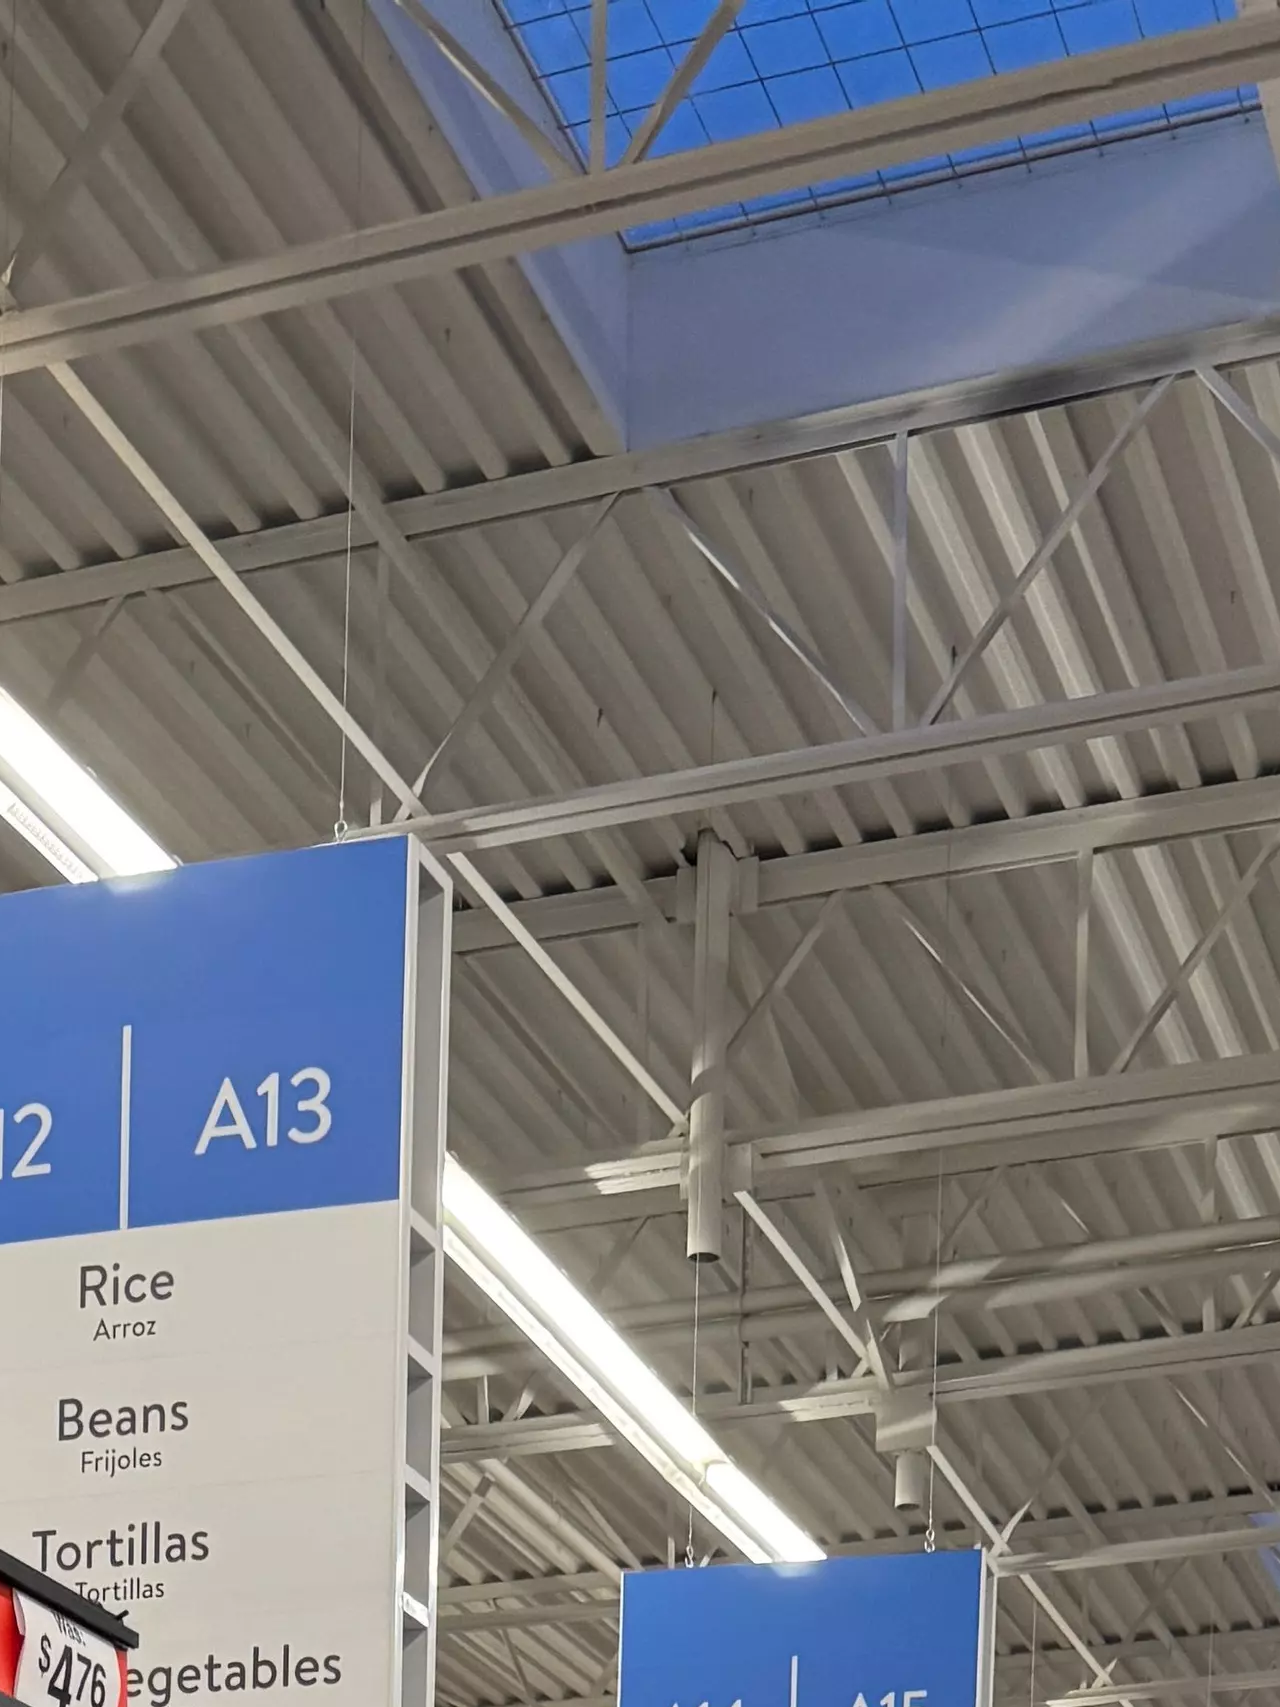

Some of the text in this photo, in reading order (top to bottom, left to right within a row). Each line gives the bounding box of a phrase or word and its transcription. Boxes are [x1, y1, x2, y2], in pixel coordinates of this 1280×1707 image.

[194, 1067, 332, 1155] A13
[79, 1263, 174, 1309] Rice
[93, 1319, 156, 1341] Arroz
[58, 1398, 189, 1441] Beans
[80, 1449, 162, 1477] Frijoles
[32, 1521, 210, 1572] Tortillas
[75, 1578, 165, 1603] Tortillas
[126, 1643, 342, 1707] egetables
